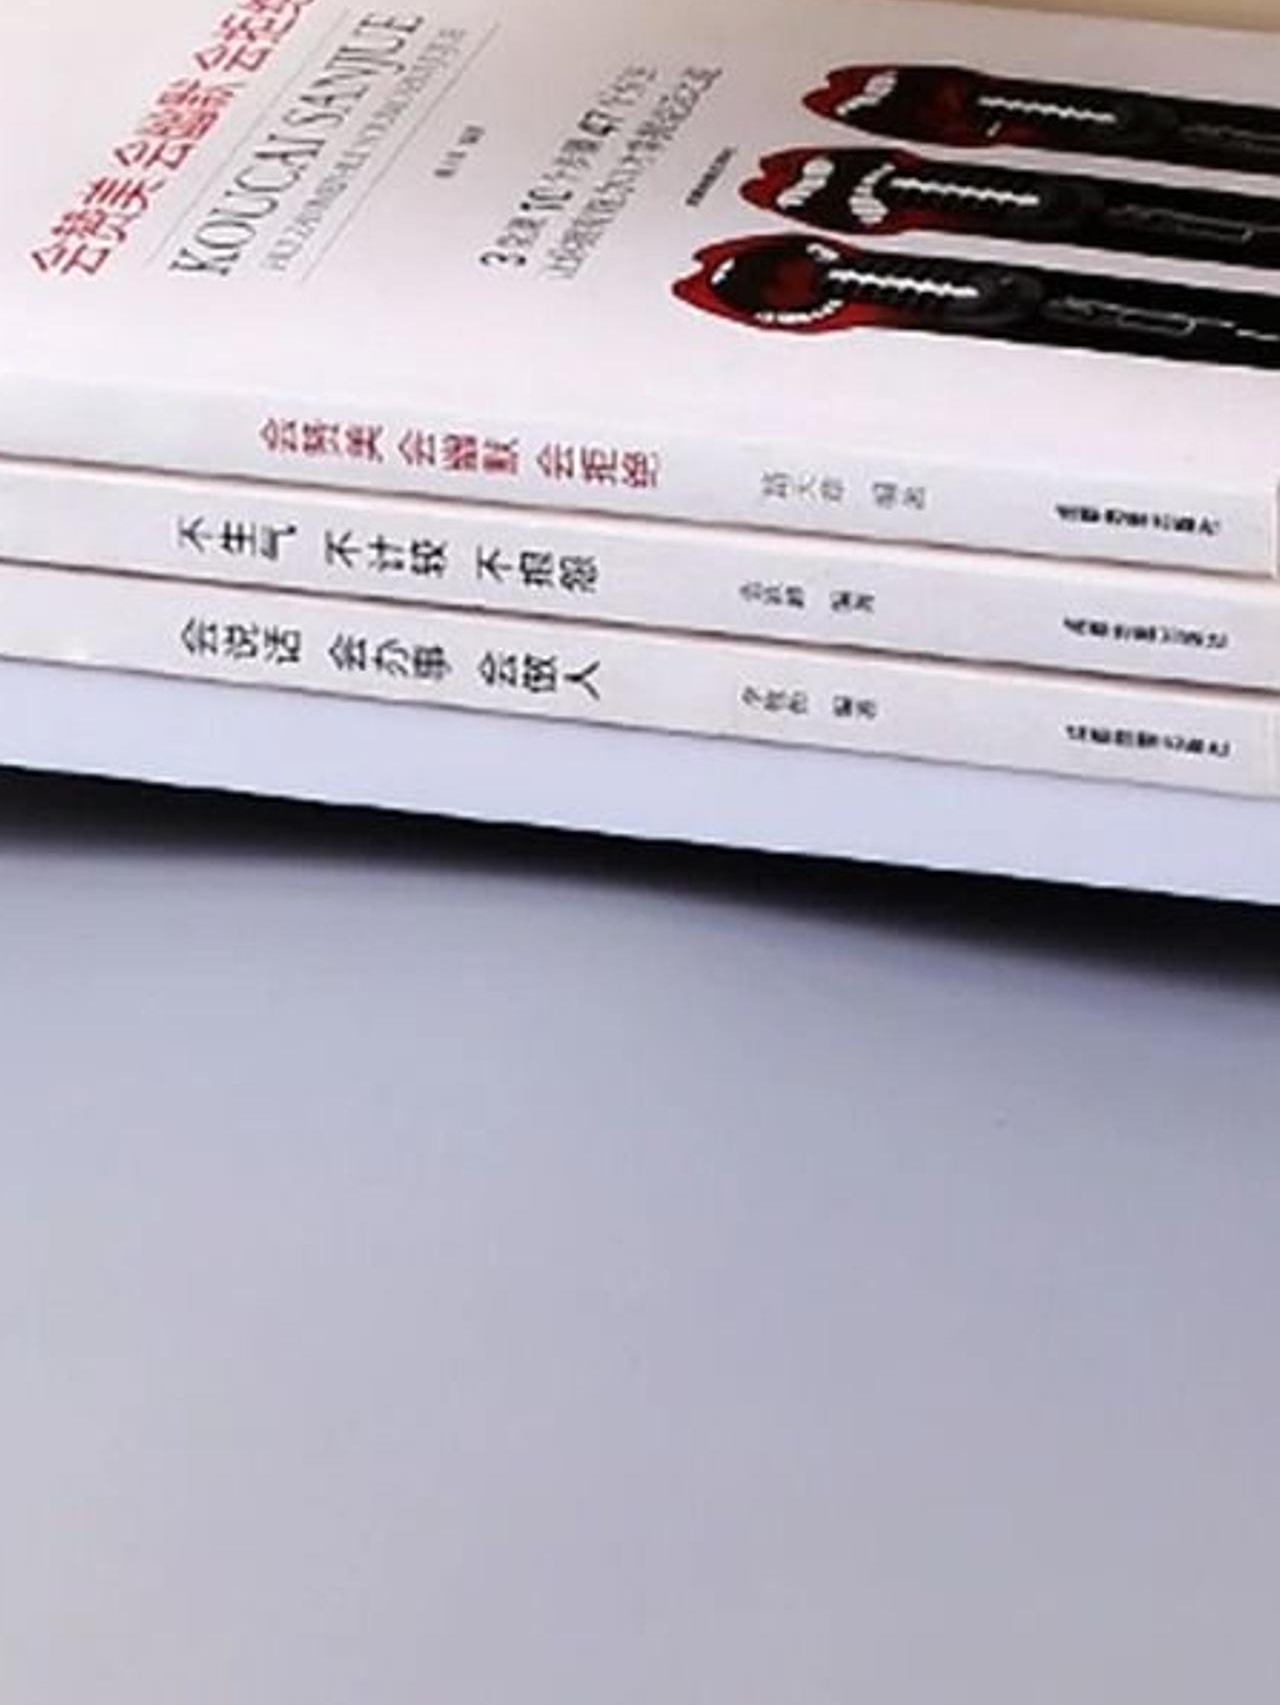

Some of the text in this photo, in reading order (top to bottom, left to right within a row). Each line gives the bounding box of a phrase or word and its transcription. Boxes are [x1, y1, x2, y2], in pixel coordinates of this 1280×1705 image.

[31, 176, 166, 276] 会赞美
[114, 78, 247, 171] 会幽默
[168, 133, 326, 277] KOUCAI
[280, 12, 425, 132] SANJUE
[257, 415, 660, 489] 会赞美 会幽默 会拒绝
[176, 515, 600, 594] 不生气 不计较 不抱怨
[180, 616, 602, 702] 会说话 会办事 会做人
